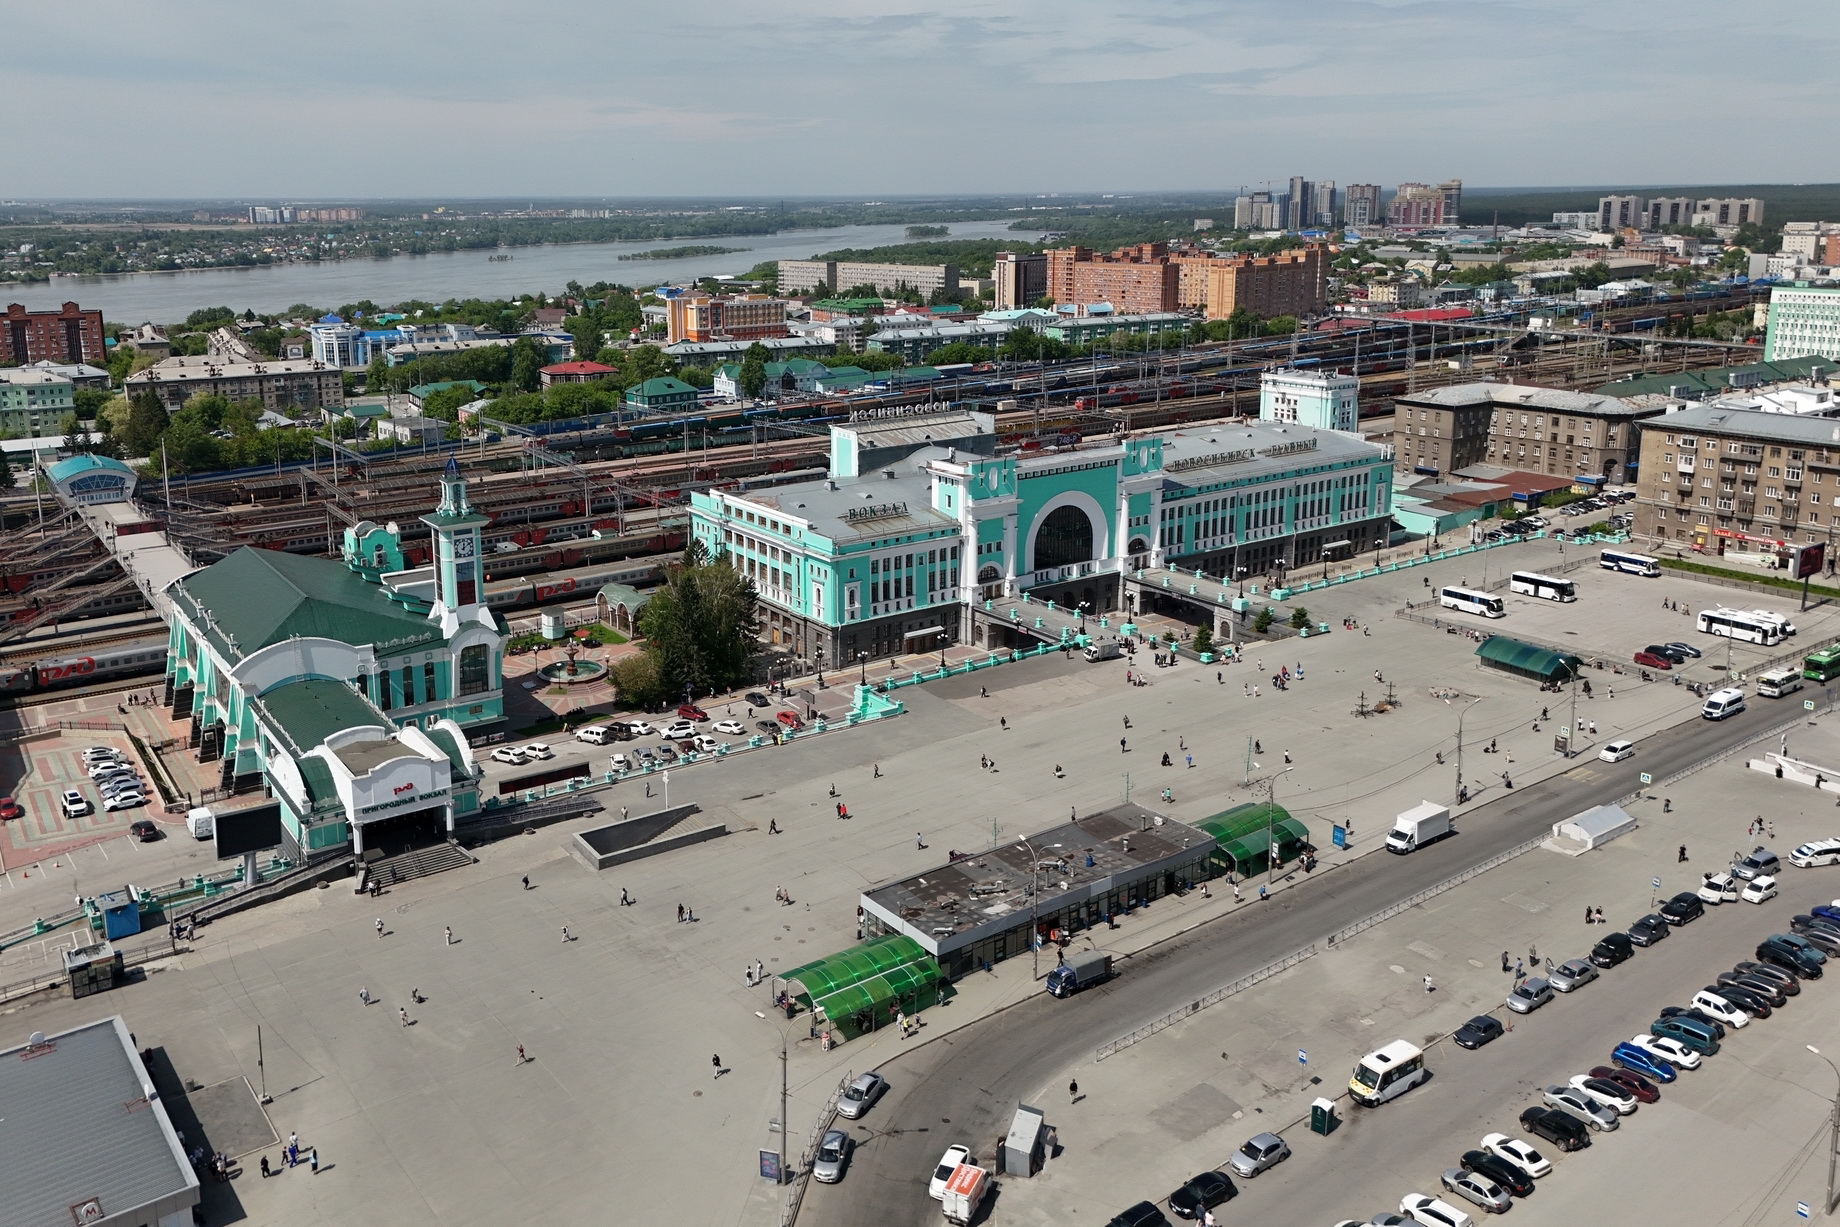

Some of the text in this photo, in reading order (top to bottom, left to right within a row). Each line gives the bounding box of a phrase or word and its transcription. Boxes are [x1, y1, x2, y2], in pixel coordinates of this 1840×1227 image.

[1173, 448, 1255, 470] НОВОСИБИРСК
[848, 502, 908, 519] ВОКЗАЛ
[362, 789, 447, 815] ПРИГОРОДНЫЙ ВОКЗАЛ
